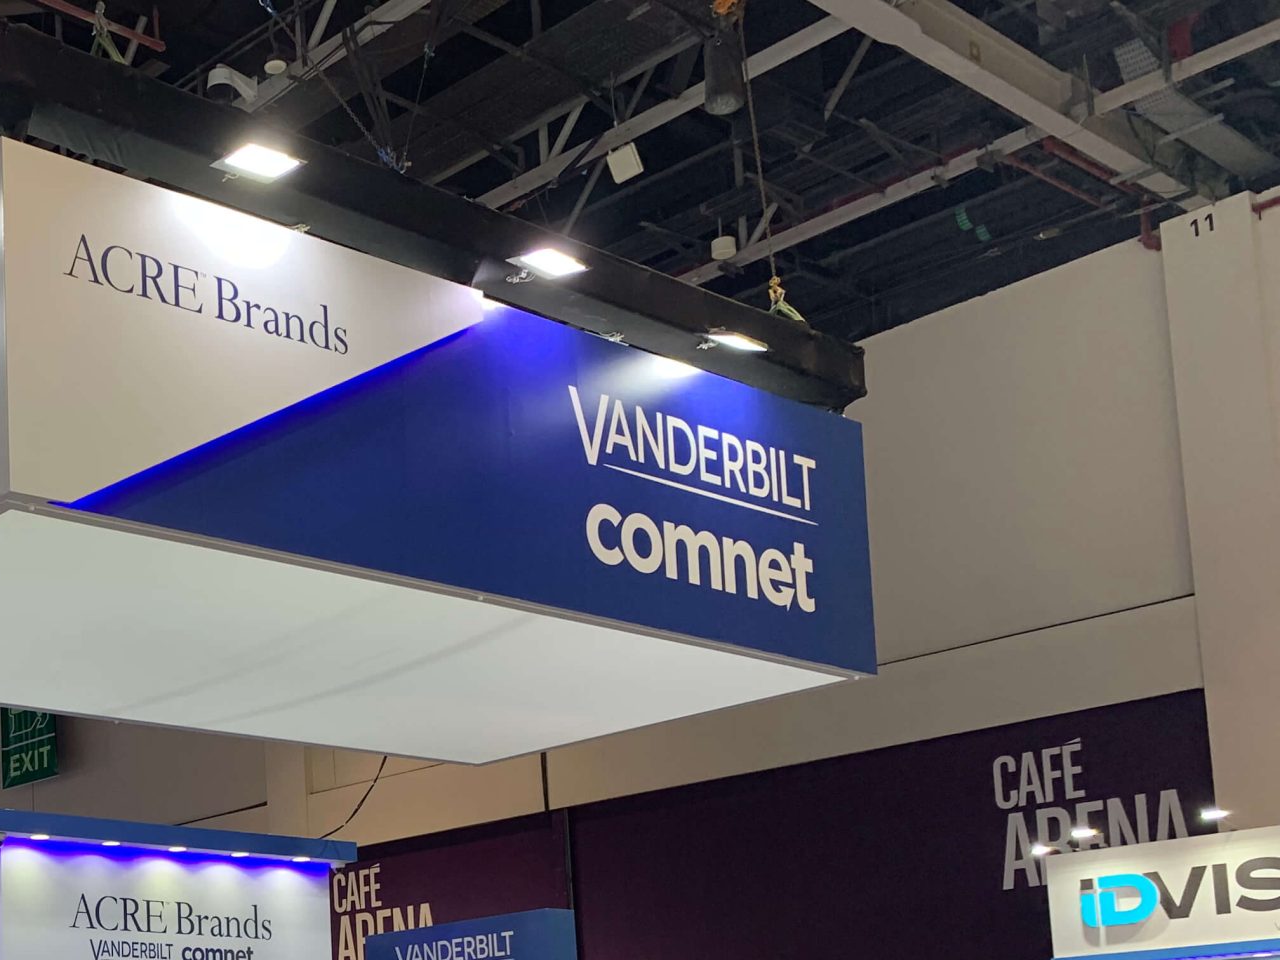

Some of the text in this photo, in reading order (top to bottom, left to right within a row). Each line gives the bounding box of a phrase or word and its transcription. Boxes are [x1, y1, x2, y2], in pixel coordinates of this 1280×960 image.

[1190, 213, 1214, 237] 11
[63, 234, 203, 314] ACRE
[214, 275, 349, 355] Brands
[568, 385, 816, 511] VANDERBILT
[586, 503, 816, 613] comnet
[10, 745, 51, 777] EXIT
[992, 737, 1086, 809] CAFÉ
[333, 863, 382, 913] CAFÉ
[69, 893, 272, 940] ACRE Brands
[90, 939, 173, 960] VANDERBILT
